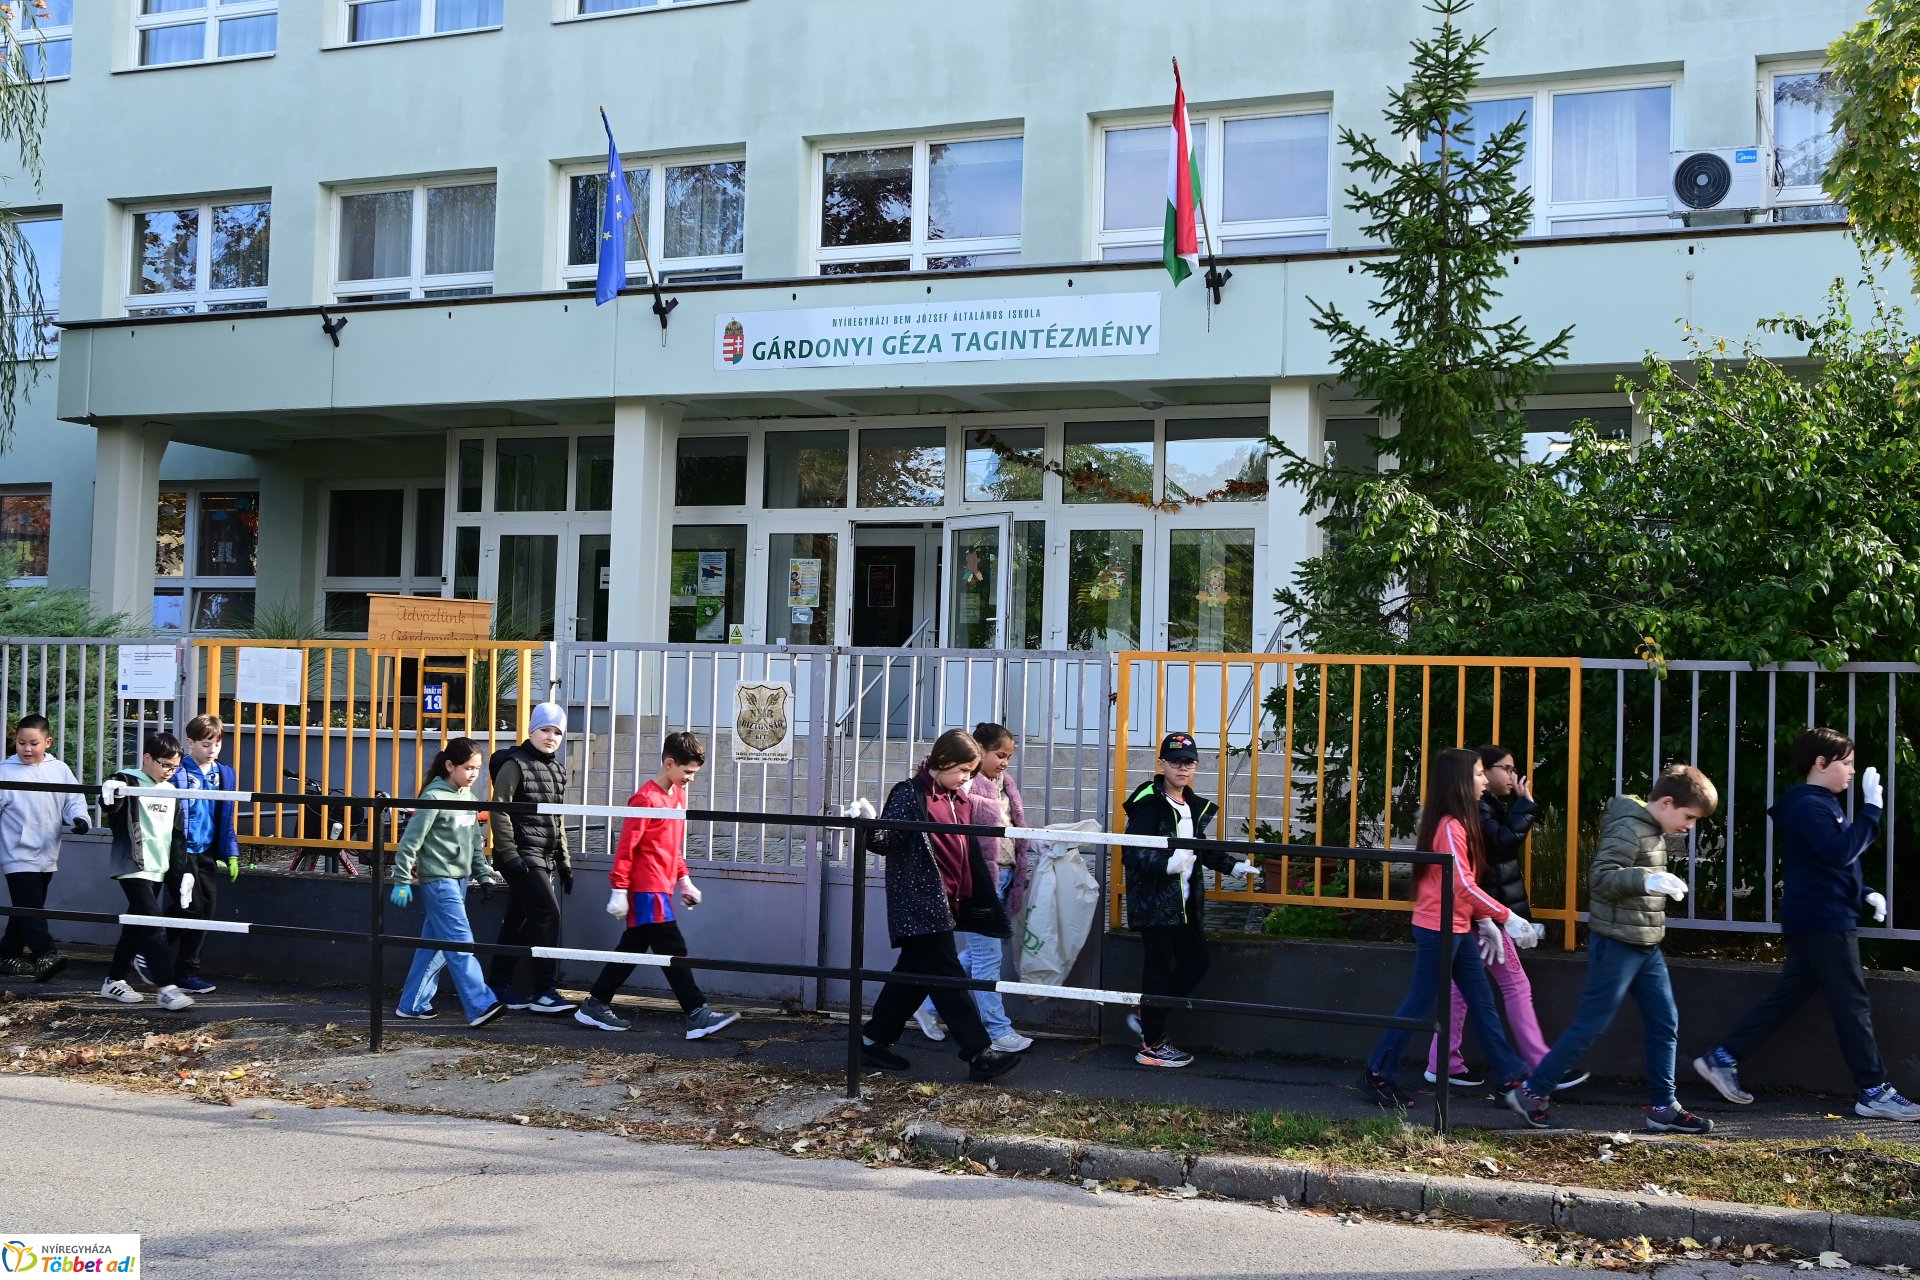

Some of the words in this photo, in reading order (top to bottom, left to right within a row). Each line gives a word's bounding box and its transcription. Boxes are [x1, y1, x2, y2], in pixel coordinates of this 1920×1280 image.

[832, 316, 889, 328] NYÍREGYHÁZI
[893, 314, 911, 325] BEM
[916, 312, 948, 324] JÓZSEF
[953, 309, 1003, 322] ÁLTALÁNOS
[1008, 308, 1041, 319] ISKOLA
[752, 335, 873, 361] GÁRDONYI
[882, 330, 942, 355] GÉZA
[951, 320, 1153, 353] TAGINTÉZMÉNY
[396, 606, 466, 624] Üdvözlünk
[380, 633, 387, 641] a
[424, 694, 443, 710] 13
